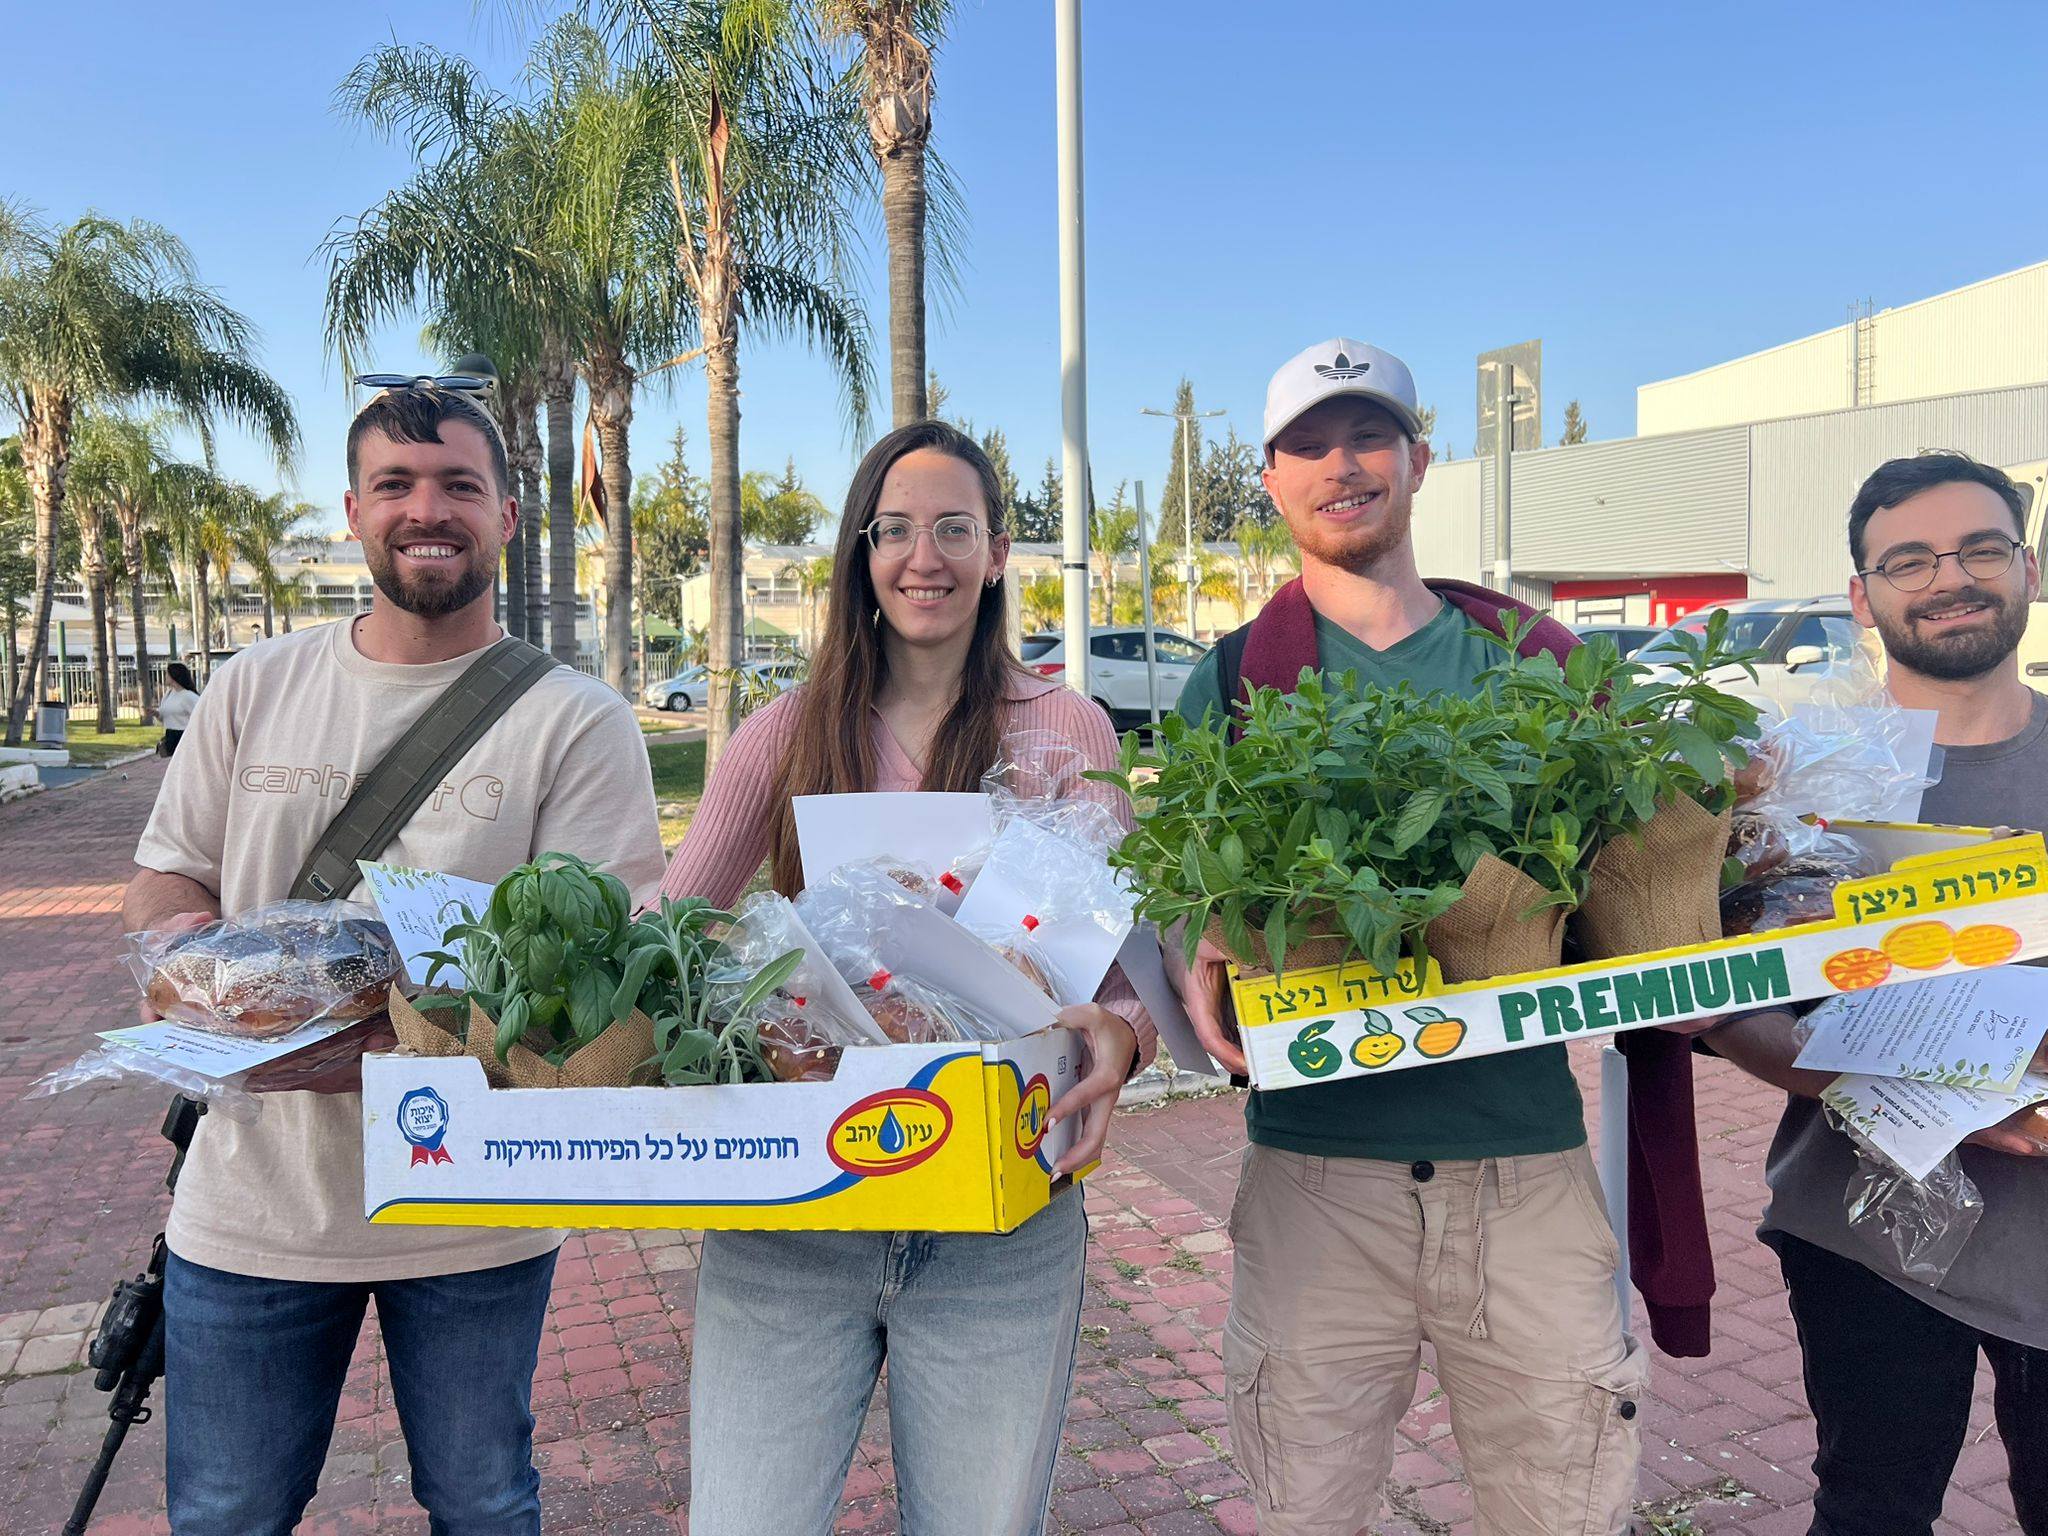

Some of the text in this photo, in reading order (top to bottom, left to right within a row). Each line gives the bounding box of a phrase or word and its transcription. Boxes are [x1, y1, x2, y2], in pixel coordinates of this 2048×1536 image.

[1848, 864, 2038, 924] פירות ניצן
[1259, 970, 1420, 1022] שדה ניצן
[1498, 947, 1791, 1043] PREMIUM
[410, 1105, 435, 1117] איכות
[414, 1114, 433, 1125] יצוא
[483, 1132, 800, 1168] חתומים על כל הפירות והירקות
[845, 1124, 933, 1148] עין יהב
